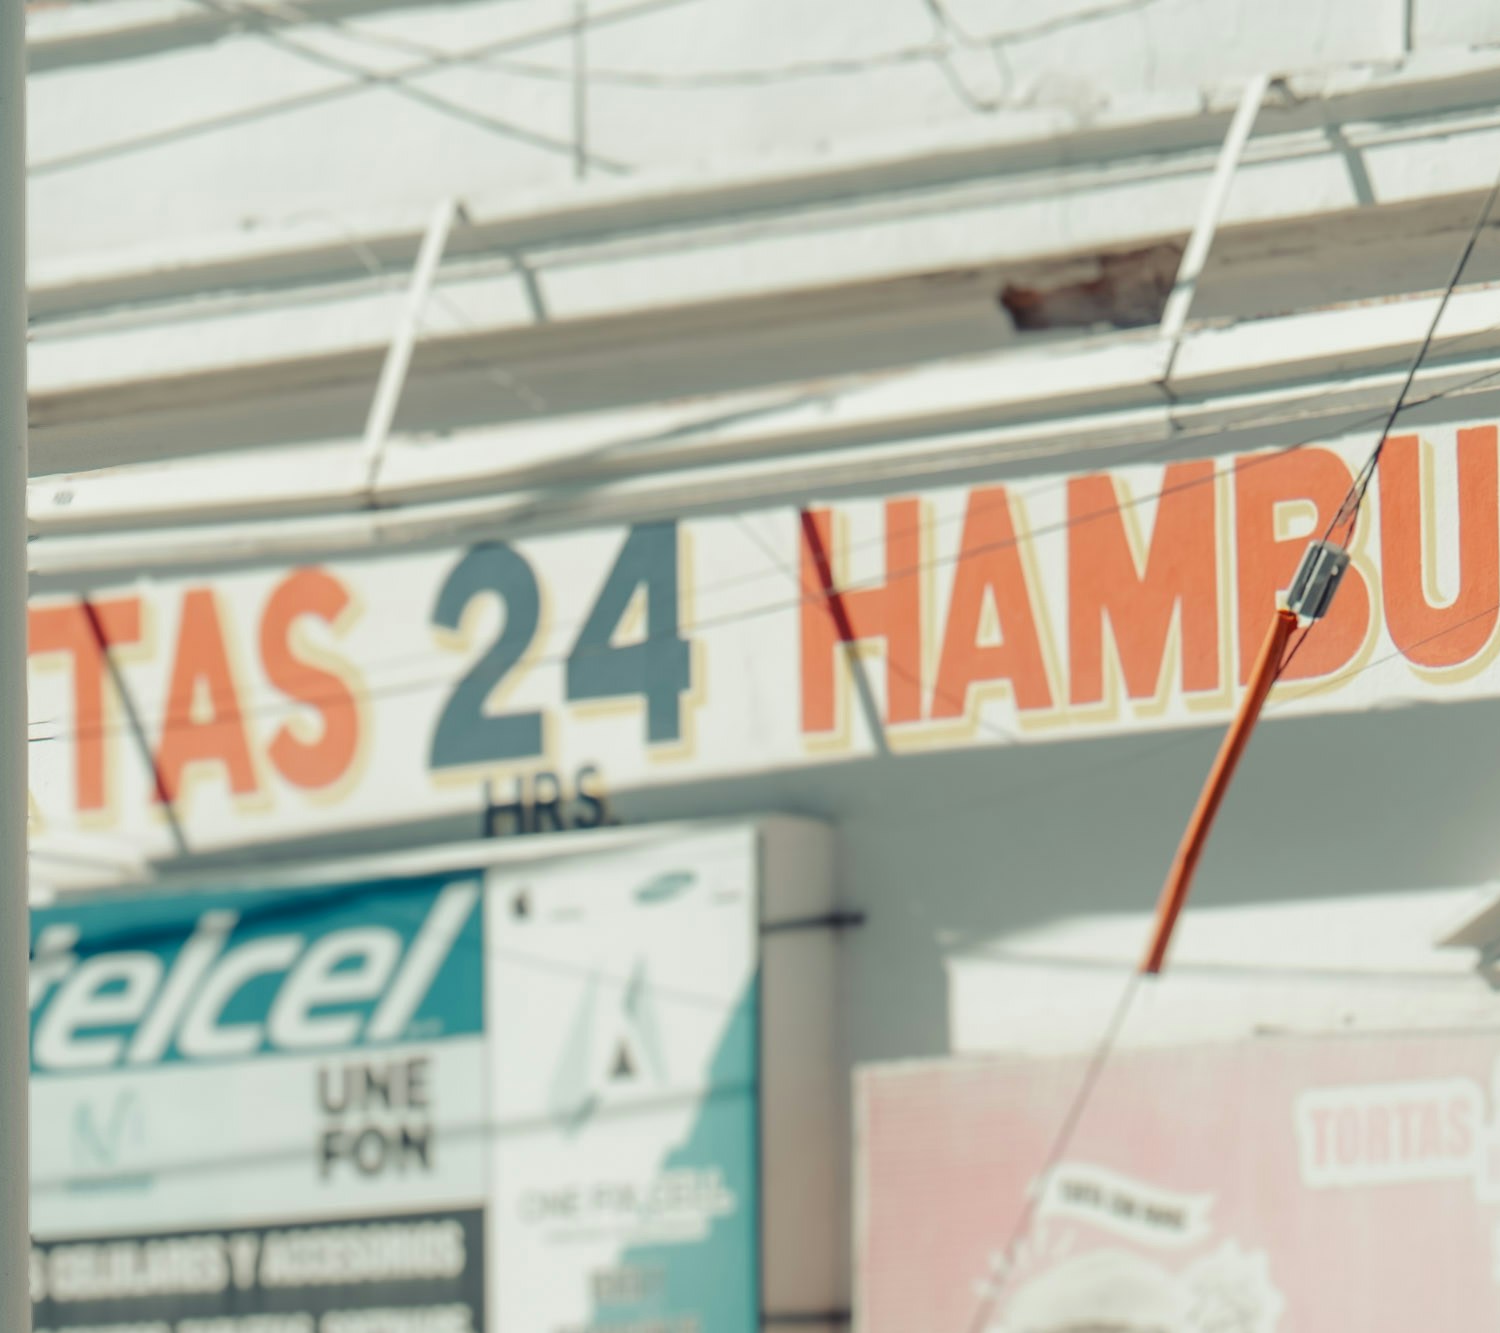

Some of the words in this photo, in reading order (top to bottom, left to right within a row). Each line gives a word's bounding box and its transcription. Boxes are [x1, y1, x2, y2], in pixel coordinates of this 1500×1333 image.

[428, 518, 696, 772] 24
[31, 880, 480, 1069] elcel
[317, 1055, 432, 1114] UNE
[317, 1127, 434, 1183] FON
[1308, 1097, 1474, 1170] TORTAS
